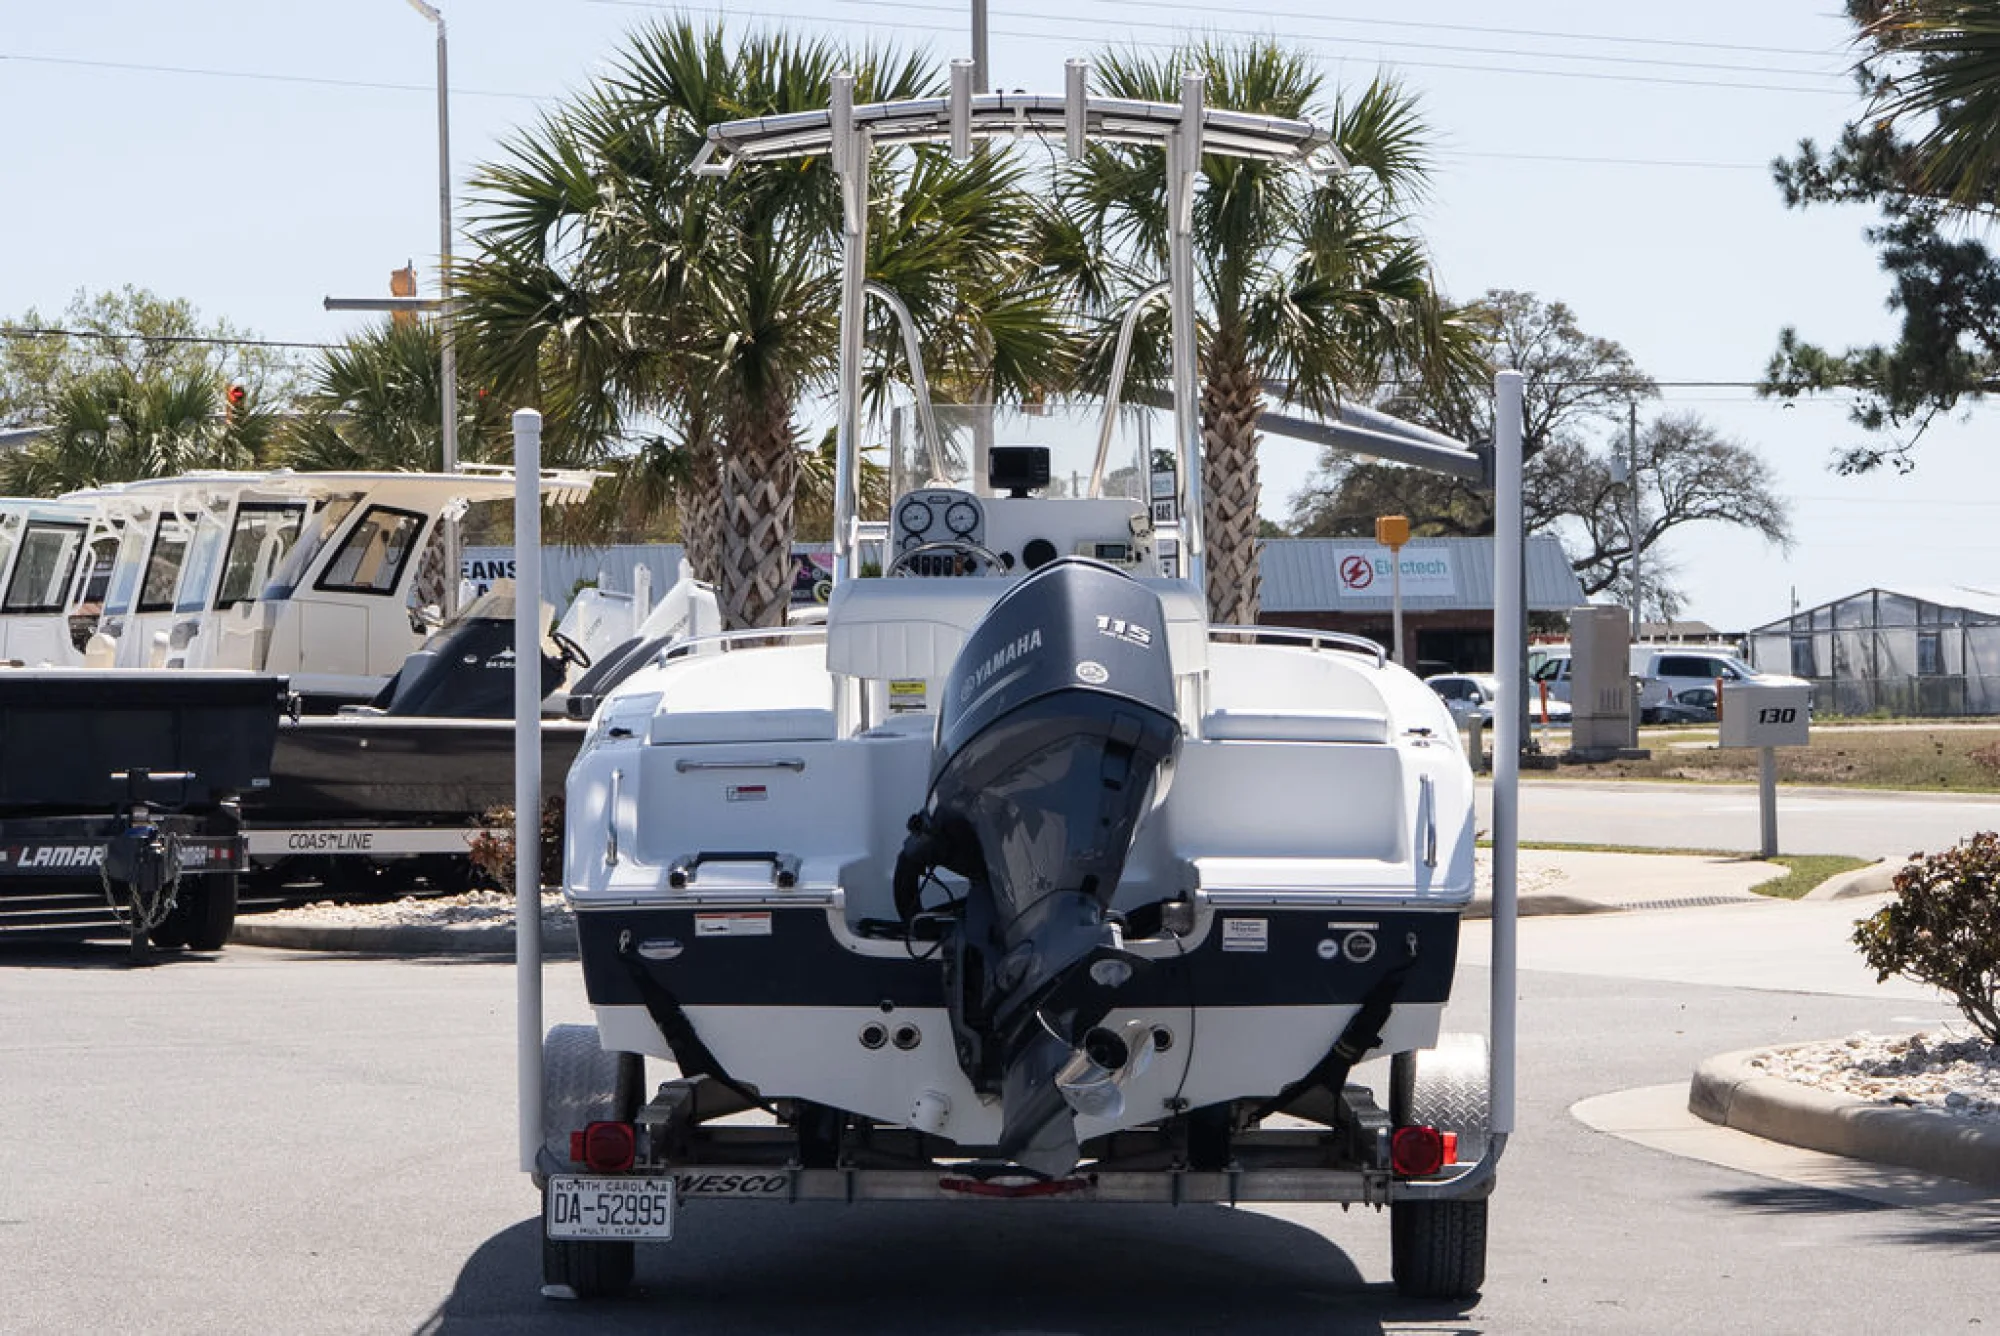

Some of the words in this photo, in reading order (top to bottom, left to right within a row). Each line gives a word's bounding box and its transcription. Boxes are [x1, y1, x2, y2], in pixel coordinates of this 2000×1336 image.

[1095, 614, 1152, 645] 115
[975, 628, 1043, 688] YAMAHA
[1759, 708, 1796, 725] 130
[289, 833, 373, 849] COASTLINE
[554, 1193, 667, 1226] DA-52995
